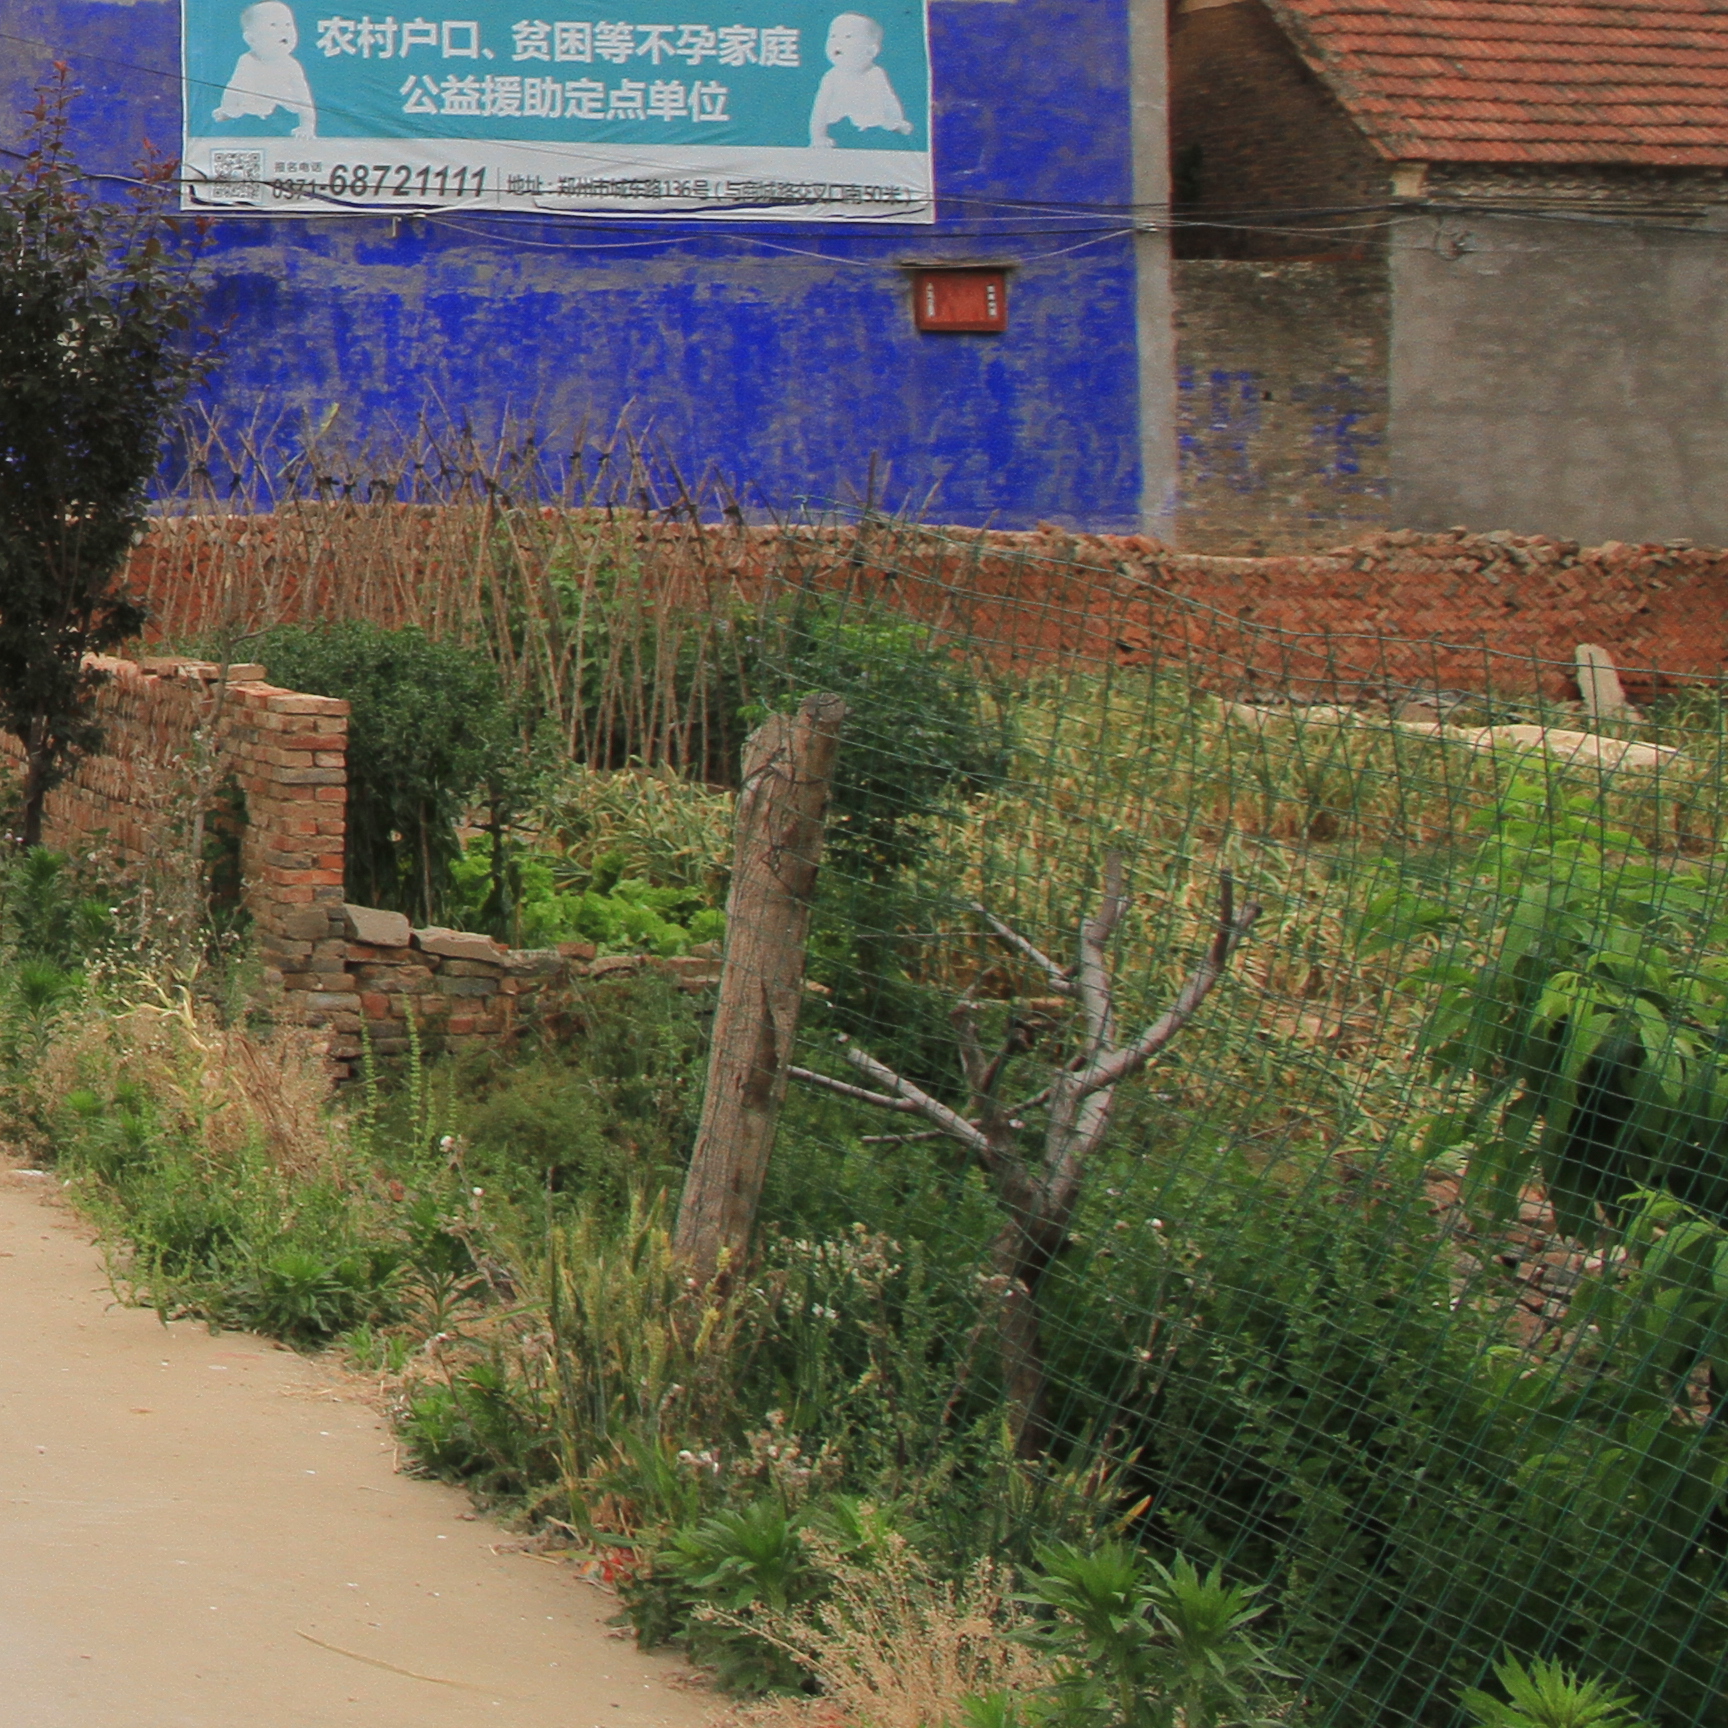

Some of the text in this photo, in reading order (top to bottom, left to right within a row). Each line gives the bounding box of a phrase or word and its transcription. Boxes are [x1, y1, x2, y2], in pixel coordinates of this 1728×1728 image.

[315, 16, 801, 68] 农村户口、贫困等不孕家庭
[399, 74, 731, 123] 公益援助定点单位
[274, 161, 322, 173] 报名电话
